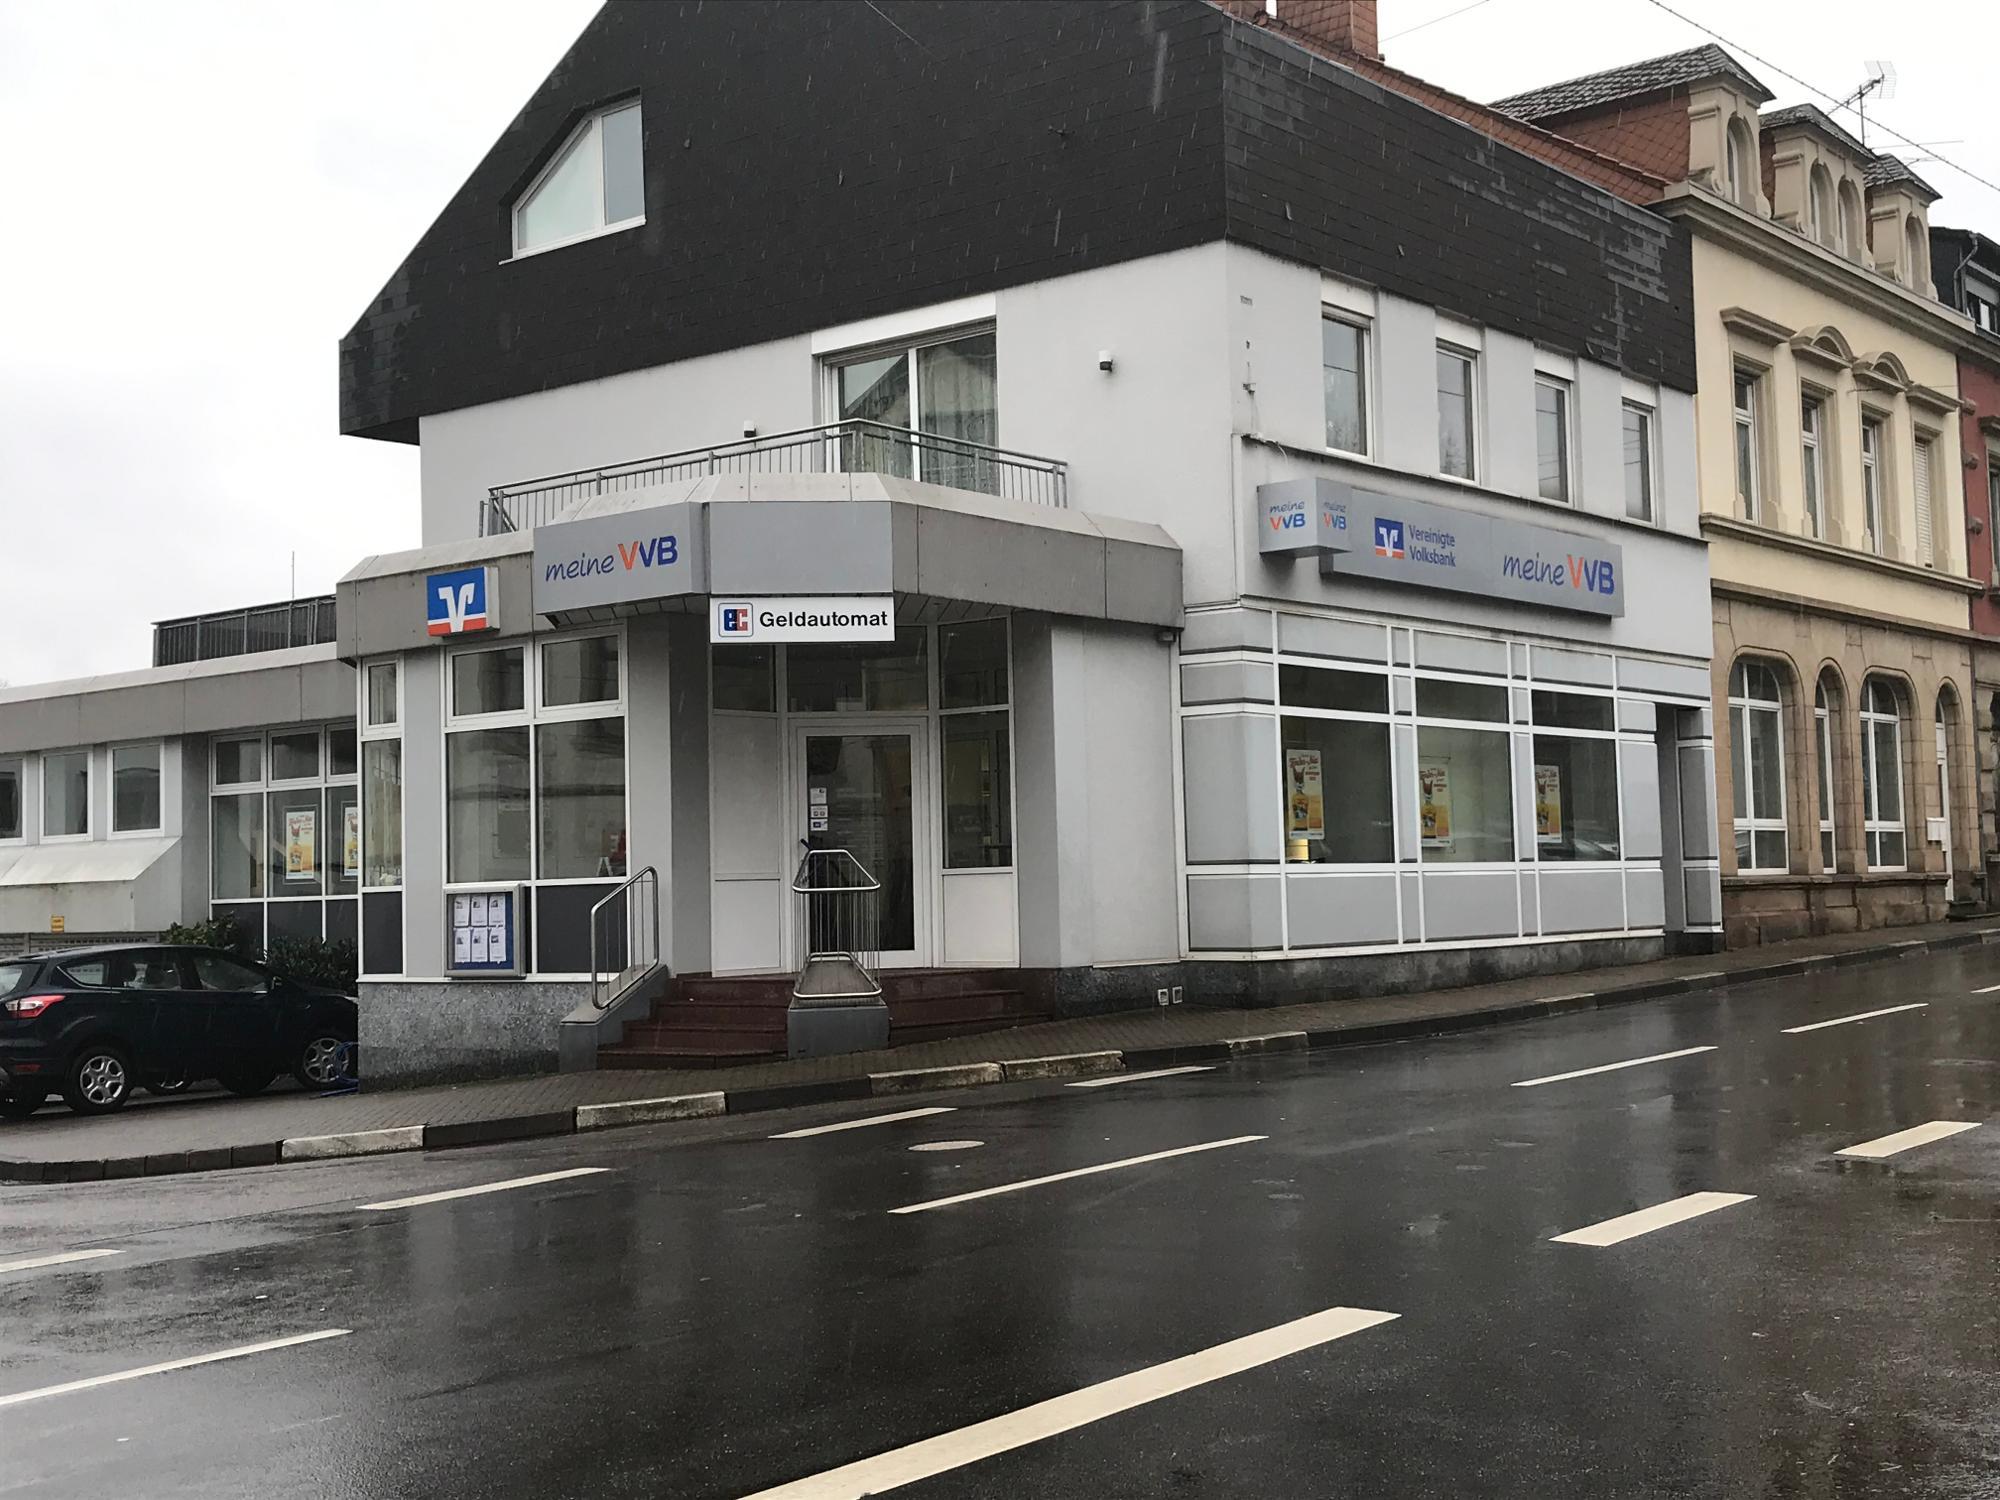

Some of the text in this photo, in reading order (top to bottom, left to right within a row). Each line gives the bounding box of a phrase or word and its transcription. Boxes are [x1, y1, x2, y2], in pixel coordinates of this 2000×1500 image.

[1269, 501, 1305, 513] meine
[1269, 513, 1306, 530] VVB
[1323, 512, 1347, 530] VVB
[1408, 524, 1456, 549] Vereinigte
[1409, 545, 1457, 568] Volksbank
[759, 611, 889, 628] Geldautomat
